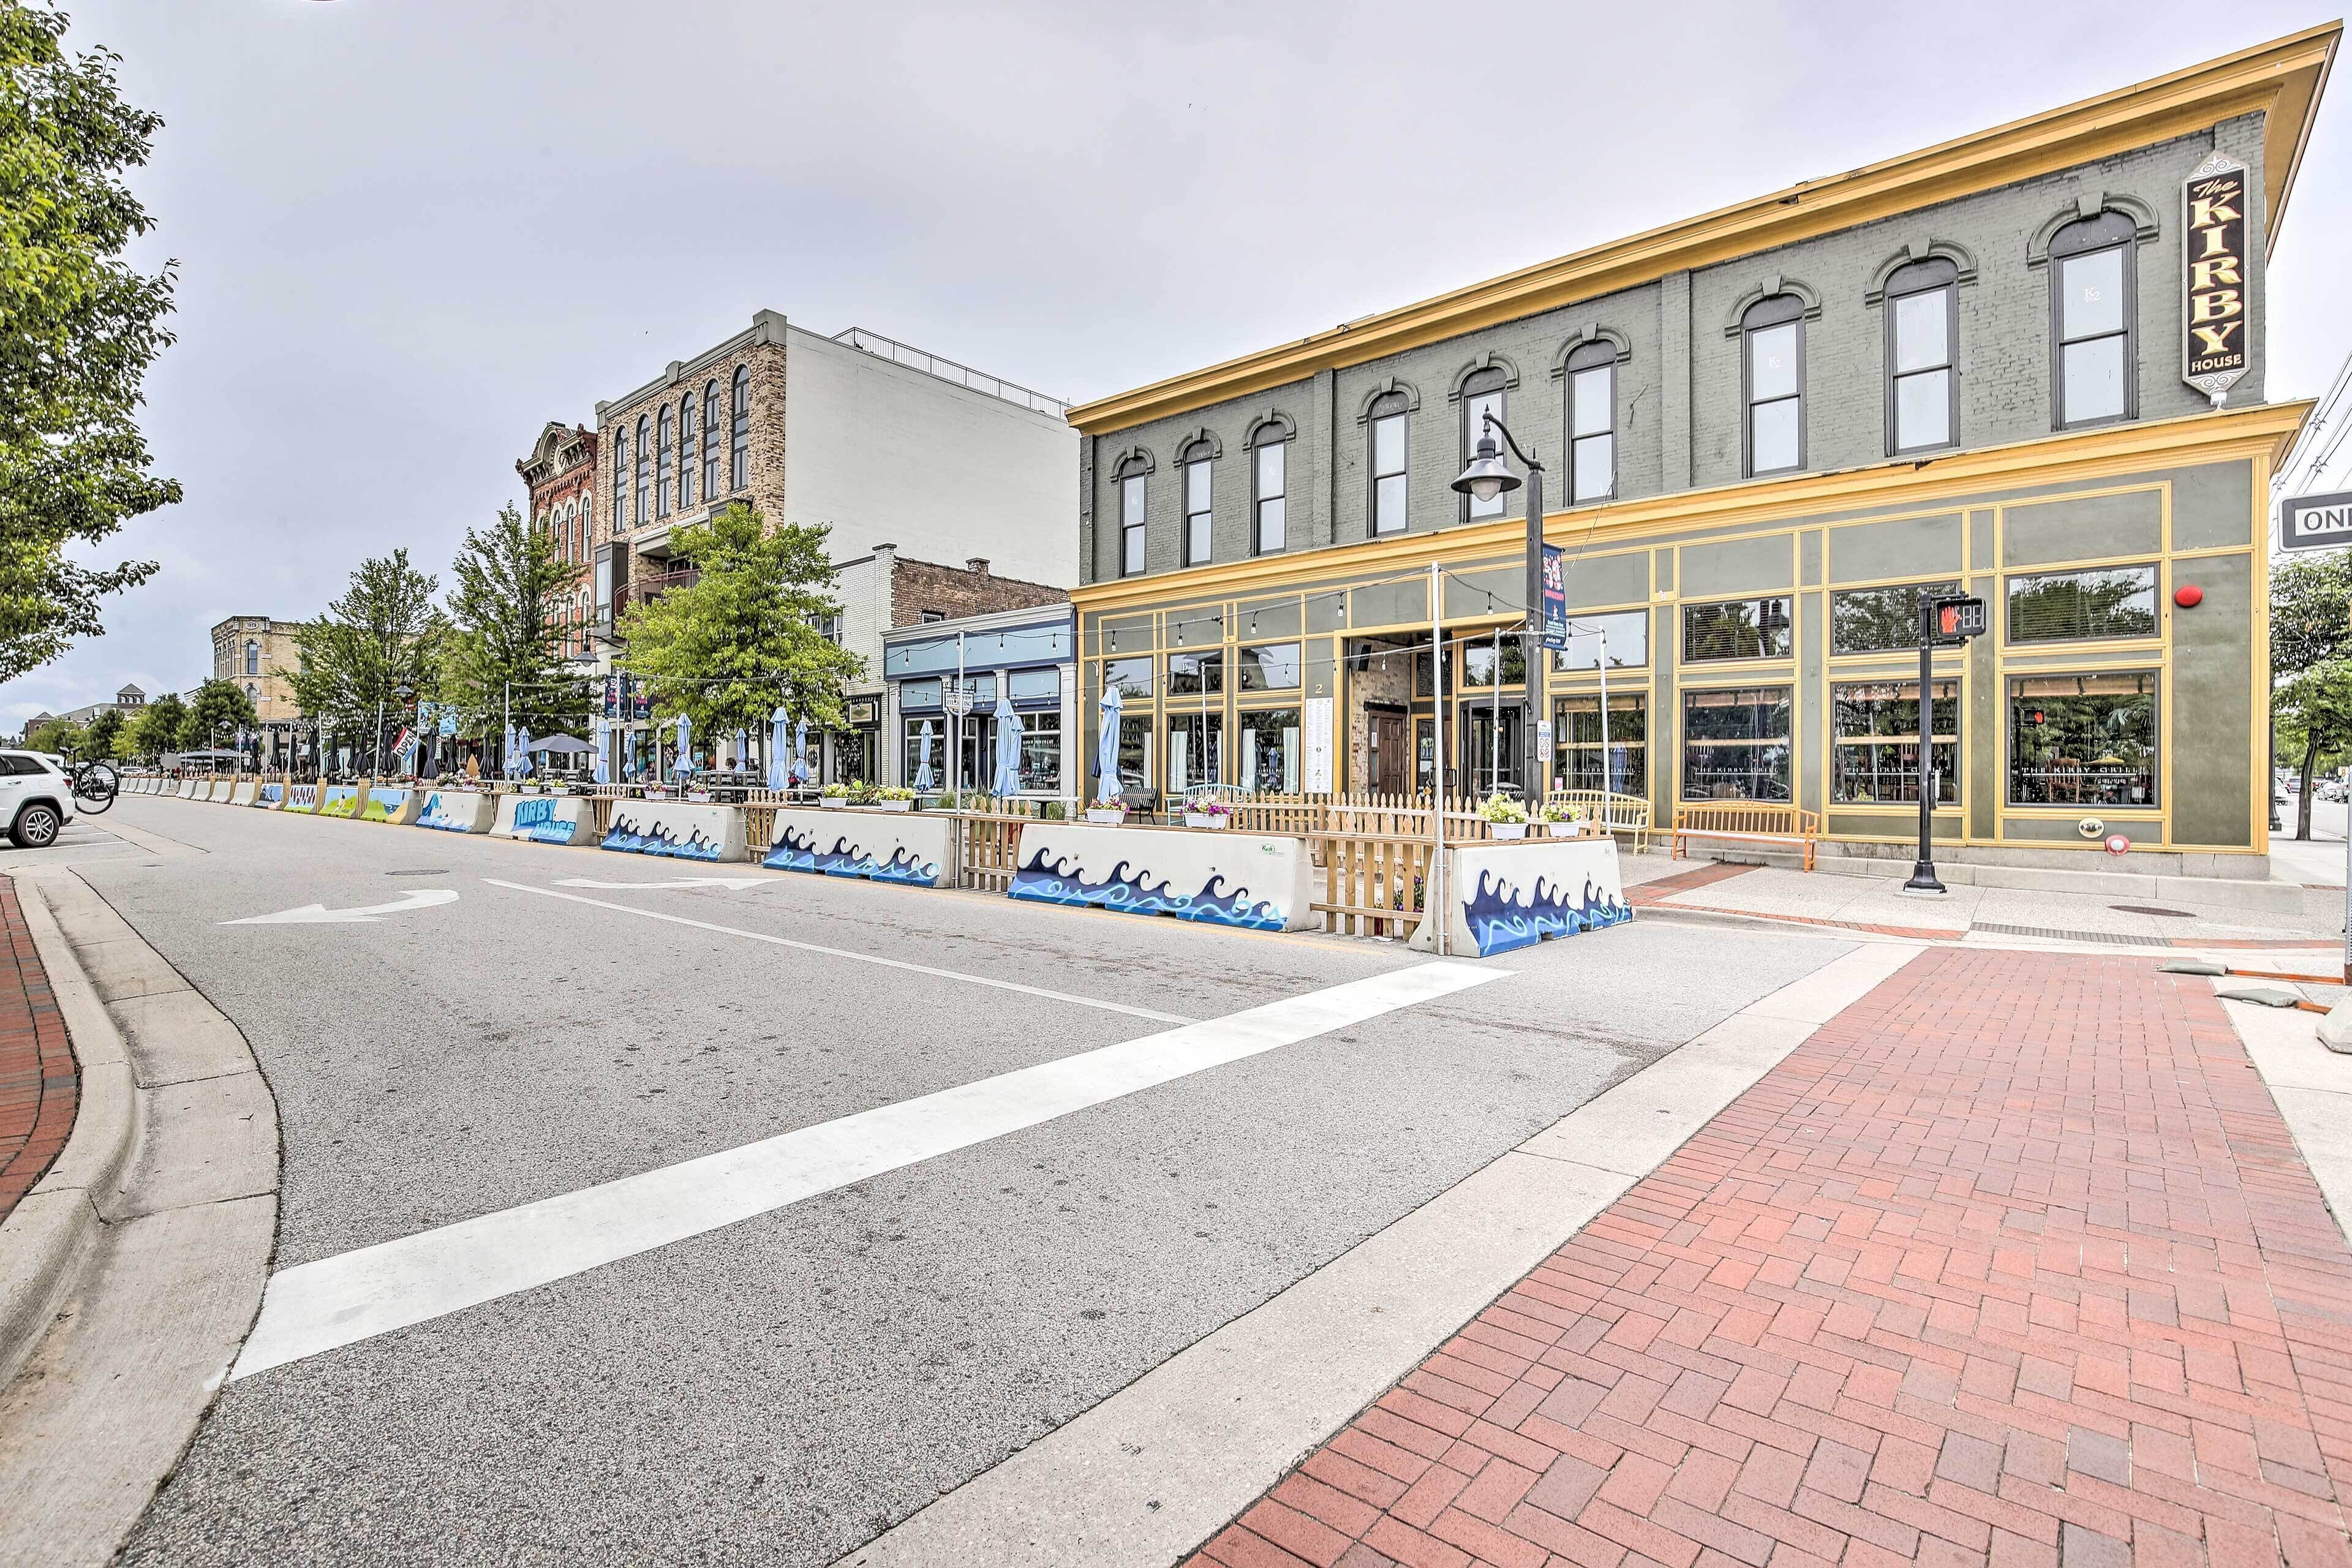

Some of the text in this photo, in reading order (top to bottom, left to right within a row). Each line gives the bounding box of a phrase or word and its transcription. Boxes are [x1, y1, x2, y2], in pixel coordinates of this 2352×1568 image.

[2193, 179, 2238, 197] The
[2190, 189, 2242, 356] KIRBY
[2192, 353, 2242, 373] HOUSE
[1315, 684, 1323, 695] 2
[397, 731, 417, 756] OPEN
[516, 798, 557, 826] KIRBY
[532, 820, 576, 840] HOUSE
